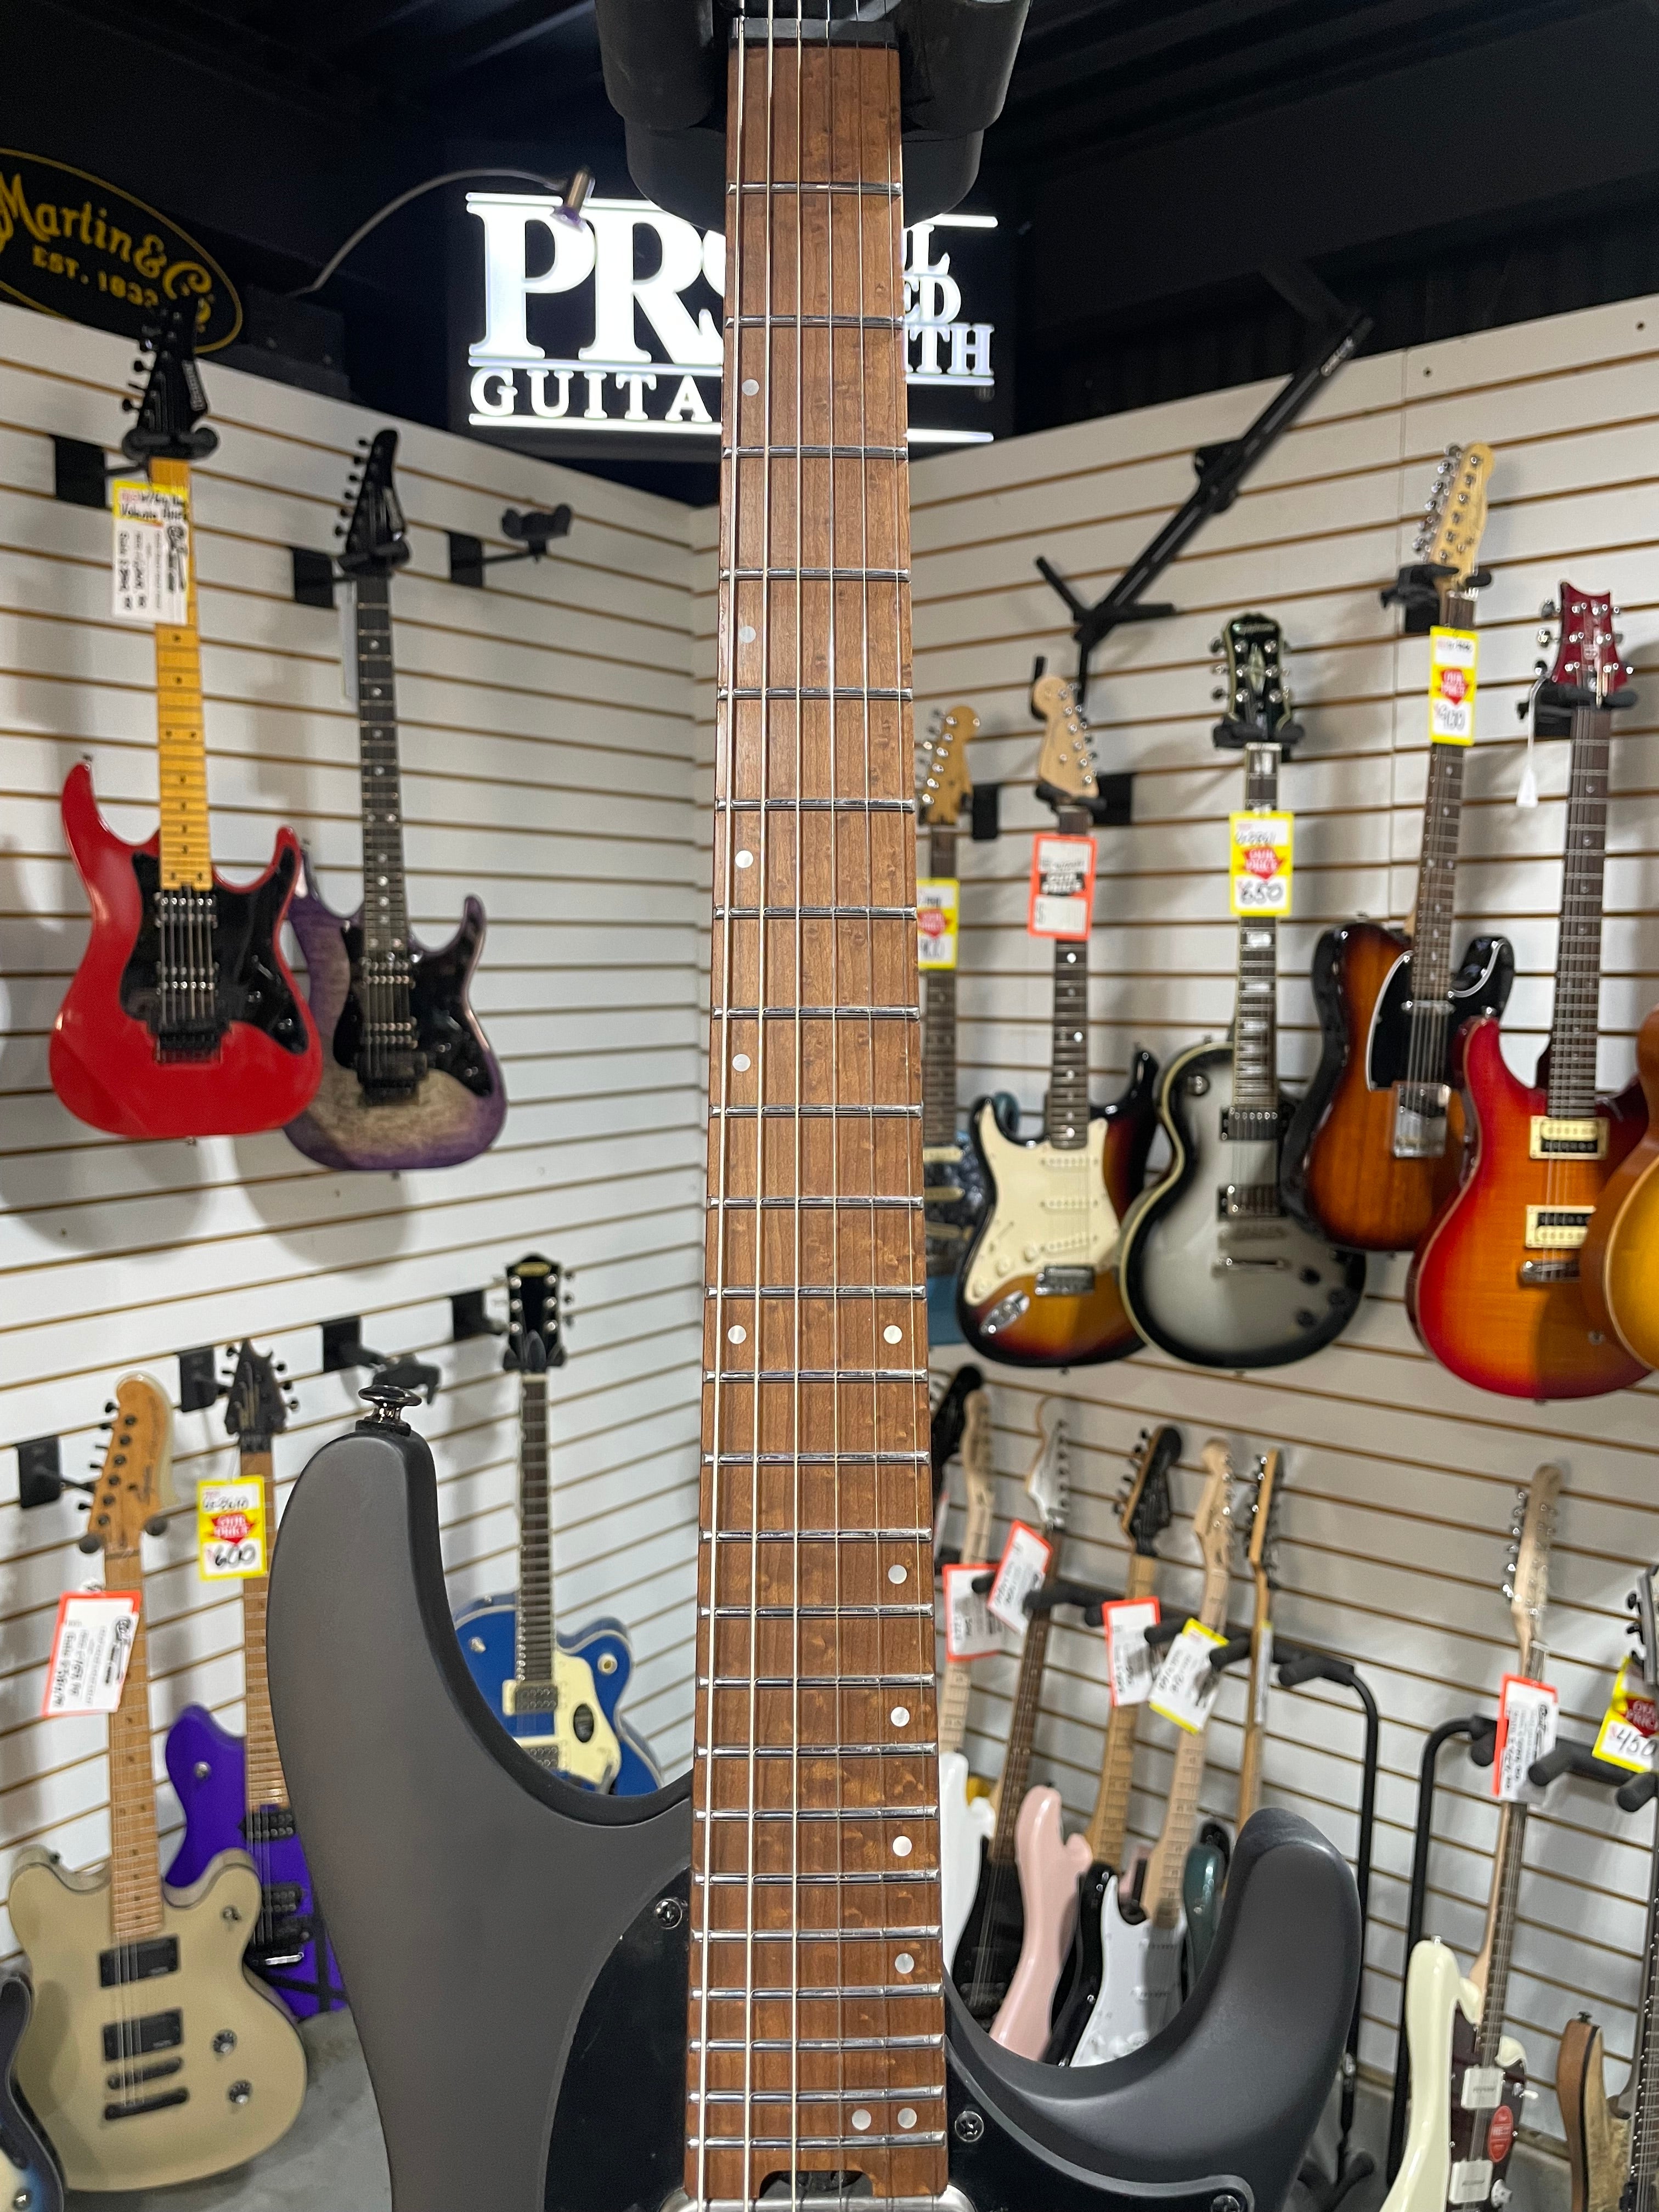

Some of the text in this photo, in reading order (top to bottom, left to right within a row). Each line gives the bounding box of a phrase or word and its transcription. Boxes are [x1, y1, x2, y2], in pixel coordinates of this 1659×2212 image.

[466, 202, 726, 365] PR
[470, 367, 713, 422] GUITA
[1241, 881, 1283, 904] 650
[215, 1544, 256, 1567] 600
[1616, 1728, 1657, 1756] 450
